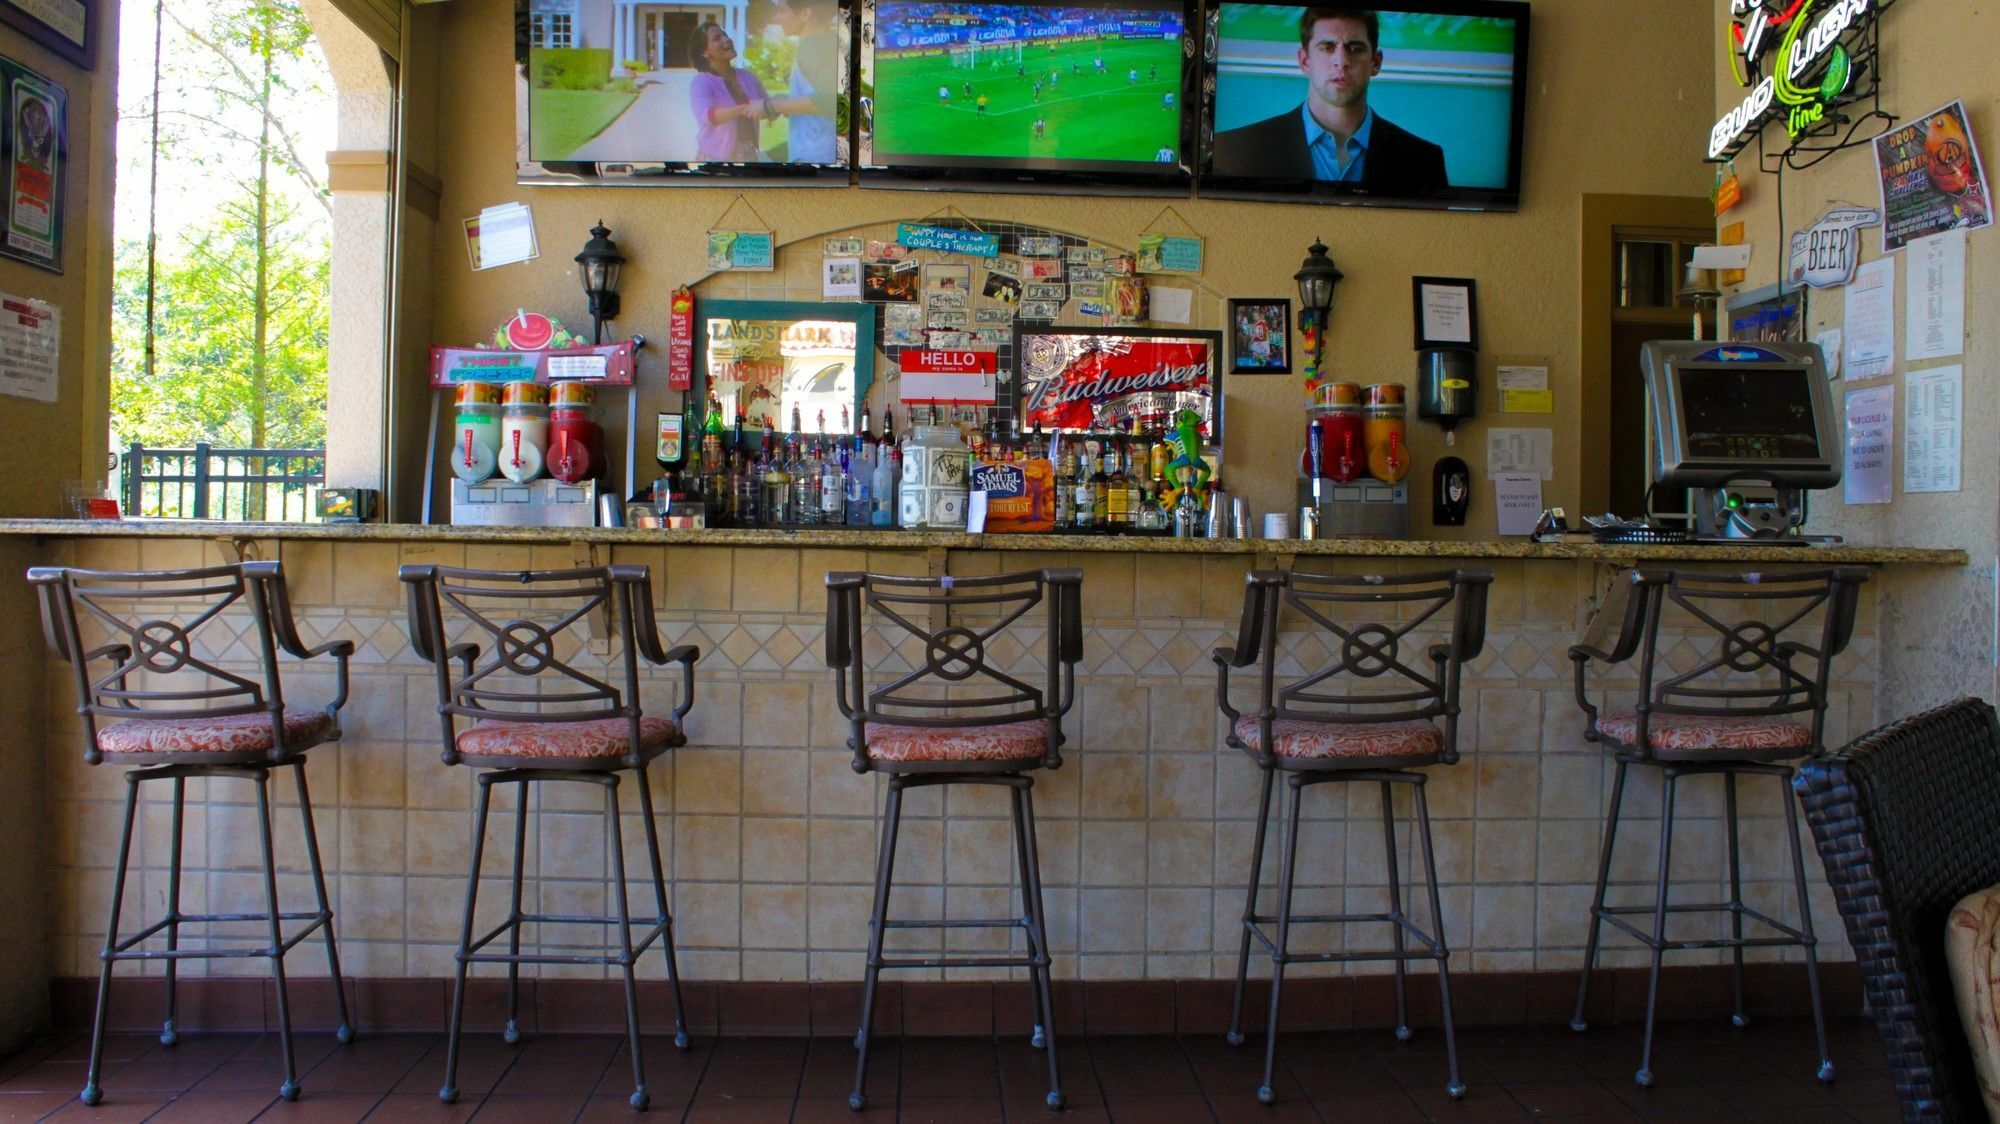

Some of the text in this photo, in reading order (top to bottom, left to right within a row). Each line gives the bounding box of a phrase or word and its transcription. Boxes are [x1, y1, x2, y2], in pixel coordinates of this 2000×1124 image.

[1708, 75, 1775, 158] BUD
[1888, 127, 1917, 148] DROP
[1900, 146, 1906, 158] A
[1882, 154, 1930, 179] PUMPKIN
[1907, 172, 1924, 183] DAY
[1888, 178, 1929, 198] CHALLENGE
[911, 227, 936, 236] HAPPY
[937, 232, 957, 240] HOUR
[1808, 228, 1849, 271] BEER
[894, 262, 911, 271] Jonny
[920, 352, 976, 366] HELLO
[1027, 361, 1206, 411] Budweiser
[1113, 400, 1164, 416] American
[1865, 445, 1884, 454] UNDER
[977, 472, 1021, 484] SAMUEL
[981, 481, 1018, 493] ADAMS
